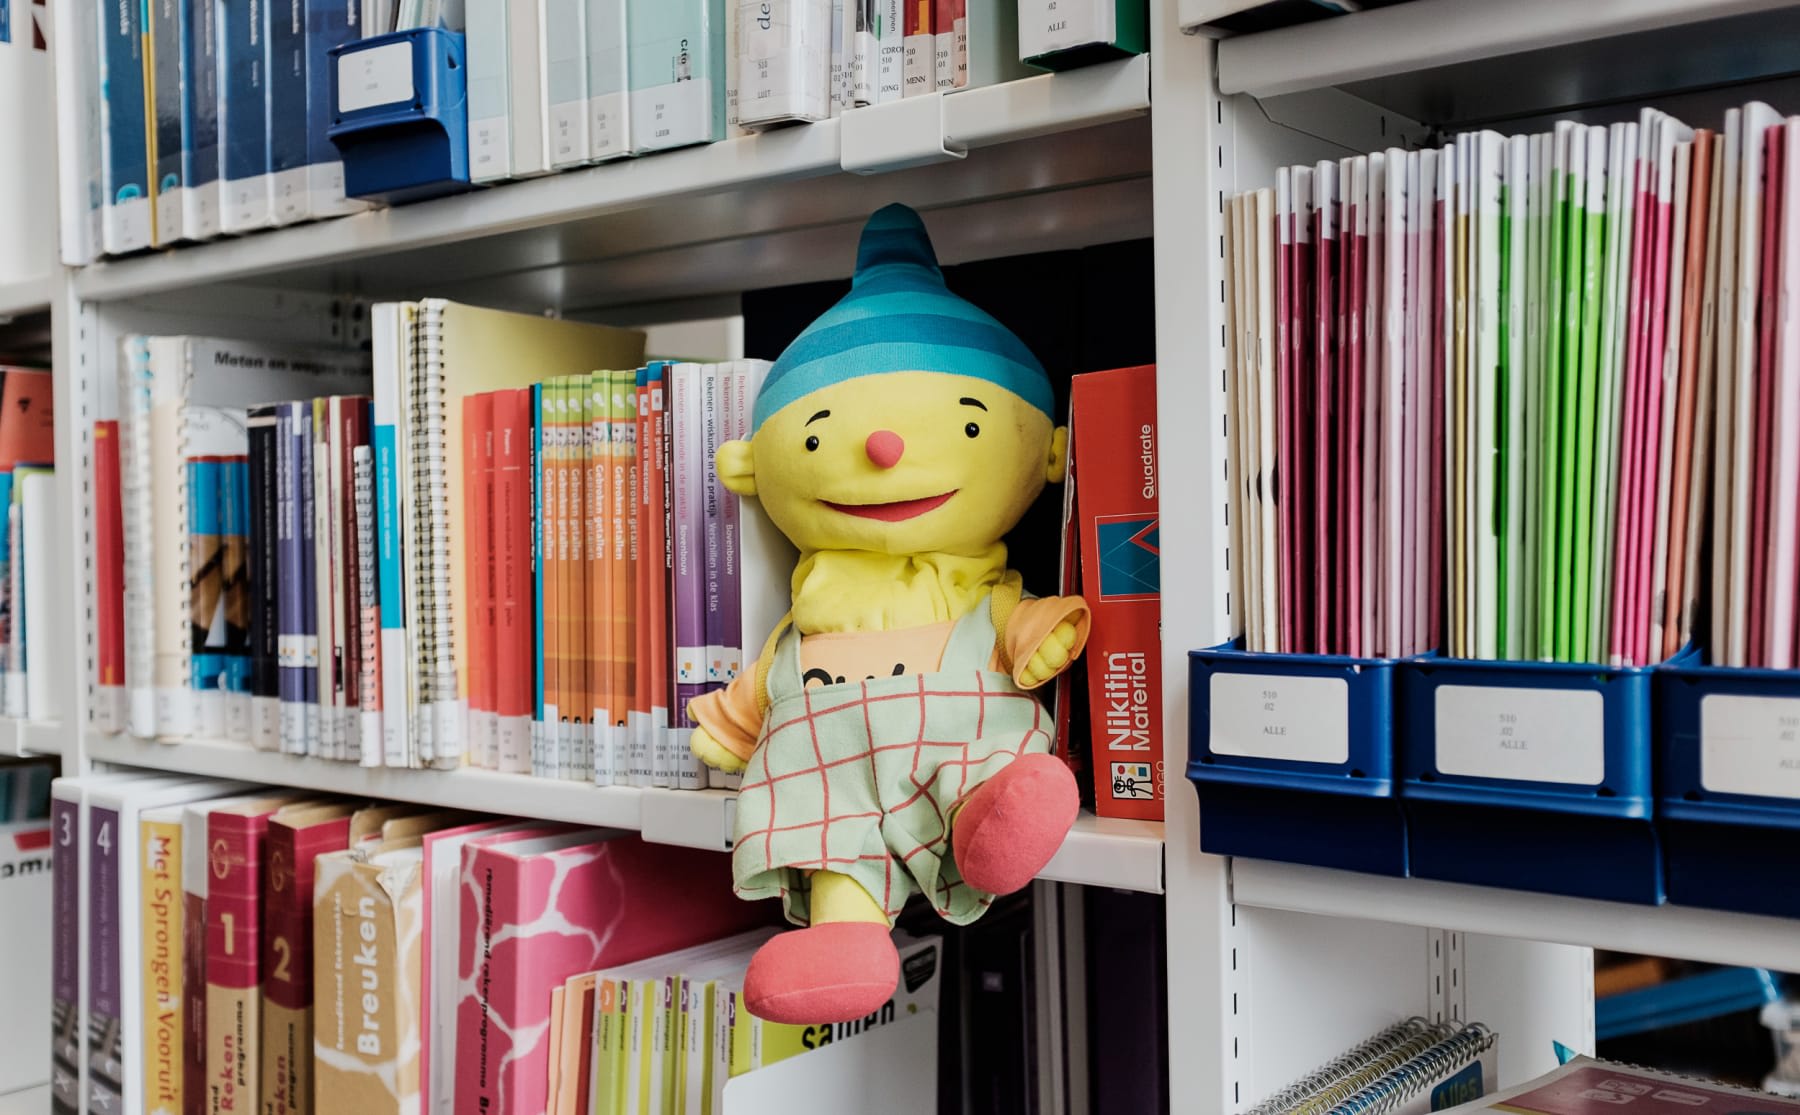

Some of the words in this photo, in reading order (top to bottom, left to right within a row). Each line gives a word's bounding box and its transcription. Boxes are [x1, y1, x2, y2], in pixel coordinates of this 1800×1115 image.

[757, 3, 771, 30] de
[1048, 21, 1067, 32] ALLE
[906, 48, 916, 56] 510
[881, 85, 899, 93] JONG
[906, 76, 926, 85] MENN
[656, 416, 664, 435] Hele
[655, 437, 663, 470] getallen
[707, 461, 716, 470] in
[1141, 424, 1155, 499] Quadrate
[545, 468, 554, 516] Gebroken
[559, 468, 568, 516] Gebroken
[571, 468, 581, 516] Gebroken
[595, 464, 605, 513] Gebroken
[615, 466, 624, 515] Gebroken
[707, 472, 716, 483] de
[677, 487, 688, 519] praktijk
[705, 486, 717, 518] praktijk
[544, 519, 554, 560] getallen
[558, 519, 569, 560] getallen
[570, 519, 581, 560] getallen
[593, 516, 605, 558] getallen
[613, 518, 625, 560] getallen
[679, 524, 689, 576] Bovenbouw
[708, 522, 718, 567] Verschillen
[725, 524, 735, 575] Bovenbouw
[709, 570, 718, 579] in
[709, 581, 719, 593] de
[709, 595, 719, 613] klas
[1104, 652, 1132, 751] Nikitin
[1127, 652, 1150, 751] Material
[1262, 690, 1277, 699] 510
[1263, 726, 1287, 736] ALLE
[1499, 739, 1529, 750] ALLE
[60, 811, 71, 847] 3
[97, 821, 112, 856] 4
[152, 836, 172, 880] Met
[220, 913, 235, 955] 1
[483, 868, 493, 959] remediërend
[151, 888, 173, 1004] Sprongen
[272, 936, 291, 983] 2
[354, 897, 380, 1056] Breuken
[236, 1000, 245, 1087] programma
[480, 962, 491, 1089] rekenprogramma
[157, 1011, 180, 1104] Vooruit
[219, 1035, 233, 1111] Reken
[287, 1022, 296, 1110] programma
[1438, 1078, 1478, 1109] Alles
